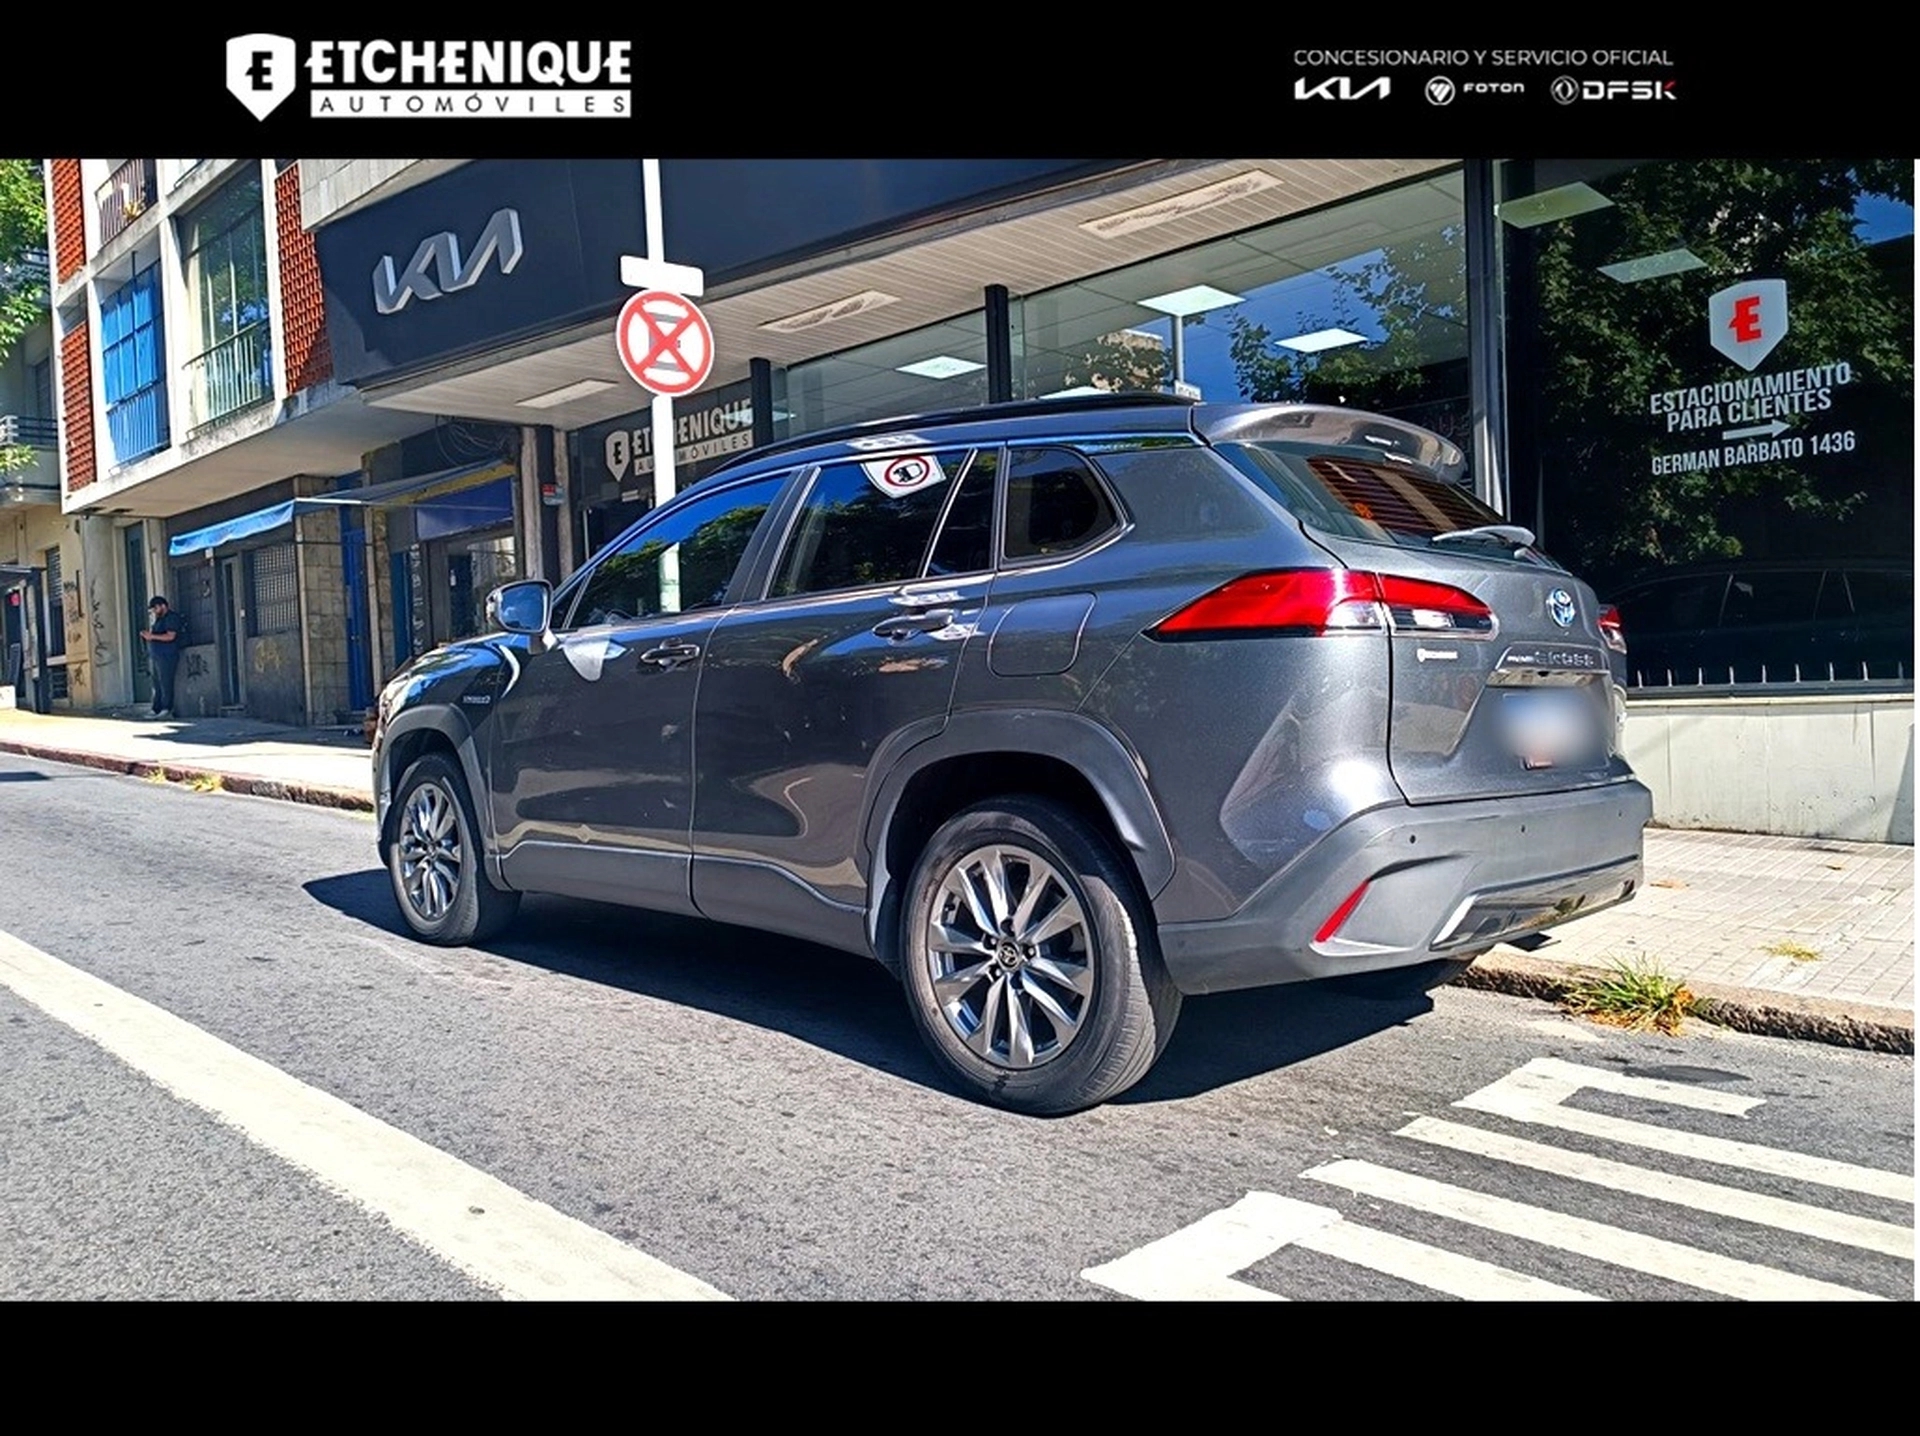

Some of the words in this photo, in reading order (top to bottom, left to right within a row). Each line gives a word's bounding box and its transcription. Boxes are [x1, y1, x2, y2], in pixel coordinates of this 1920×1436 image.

[372, 207, 523, 315] KIA
[1650, 361, 1851, 415] ESTACIONAMIENTO
[1667, 406, 1722, 432] PARA
[1728, 388, 1832, 423] CLIENTES
[632, 398, 752, 455] ETENIQUE
[637, 433, 749, 472] AUMÓVILES
[1651, 448, 1720, 476] GERMAN
[1724, 437, 1803, 467] BARBATO
[1810, 430, 1856, 455] 1436
